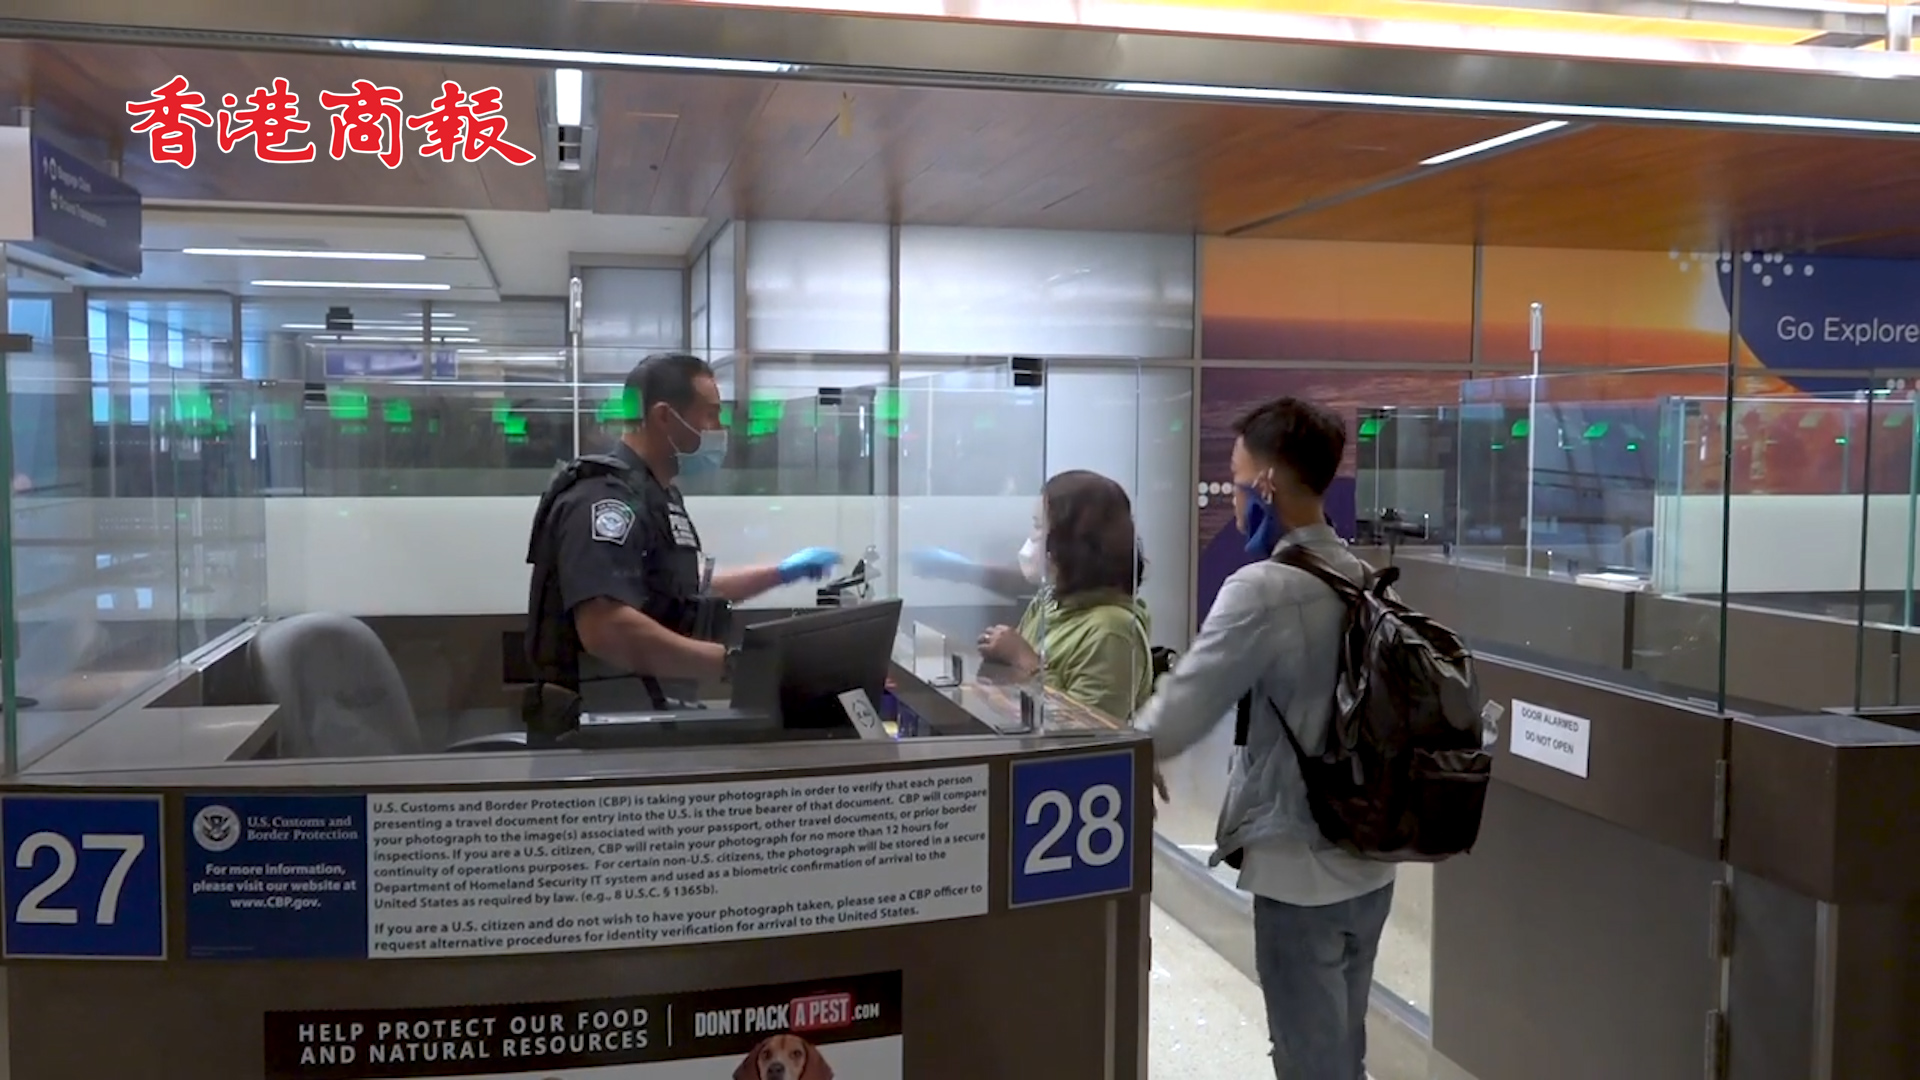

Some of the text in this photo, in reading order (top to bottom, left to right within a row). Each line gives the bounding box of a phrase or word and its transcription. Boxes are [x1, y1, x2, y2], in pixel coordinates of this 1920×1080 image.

[1777, 315, 1920, 346] Go Explore
[1521, 707, 1579, 732] DOOR ALARMED
[1525, 730, 1574, 754] DO NOT OPEN
[372, 775, 973, 813] U.S. Customs and Border Protection (CBP) is taking your photograph in order to verify that each person
[372, 817, 442, 831] presenting
[455, 816, 493, 827] travel
[494, 815, 559, 826] document
[560, 813, 579, 823] for
[581, 813, 615, 825] entry
[617, 811, 643, 821] into
[644, 809, 665, 820] the
[667, 808, 691, 819] U.S.
[693, 807, 703, 818] is
[705, 806, 726, 817] the
[727, 807, 753, 816] true
[755, 804, 793, 814] bearer
[795, 800, 807, 811] of
[809, 800, 833, 810] that
[834, 796, 894, 808] document.
[897, 792, 920, 803] CBP
[921, 790, 941, 801] will
[942, 788, 987, 800] compare
[247, 816, 353, 828] U.S. Customs and
[247, 829, 359, 841] Border Protection
[372, 803, 977, 847] your photograph to the image(s) associated with your passport, other travel documents, or prior border
[1023, 783, 1125, 875] 28
[373, 820, 949, 863] inspections. If you are a U.S. citizen, CBP will retain your photograph for no more than 12 hours for
[15, 831, 146, 925] 27
[205, 863, 346, 876] For more information,
[192, 880, 357, 894] please visit our website at
[230, 896, 322, 911] www.CBP.gov.
[373, 897, 417, 908] United
[419, 896, 459, 907] States
[461, 898, 475, 906] as
[477, 893, 532, 907] required
[535, 893, 550, 905] by
[552, 892, 579, 902] law.
[614, 889, 622, 899] 8
[624, 887, 661, 899] U.S.C.
[673, 883, 718, 896] 1365b).
[374, 884, 982, 936] If you are a U.S. citizen and do not wish to have your photograph taken, please see a CBP officer to
[373, 906, 919, 952] request alternative procedures for identity verification for arrival to the United States.
[299, 1008, 649, 1043] HELP PROTECT OUR FOOD
[695, 1009, 742, 1037] DONT
[745, 1004, 789, 1032] PACK
[794, 1007, 806, 1027] A
[300, 1029, 648, 1065] AND NATURAL RESOURCES
